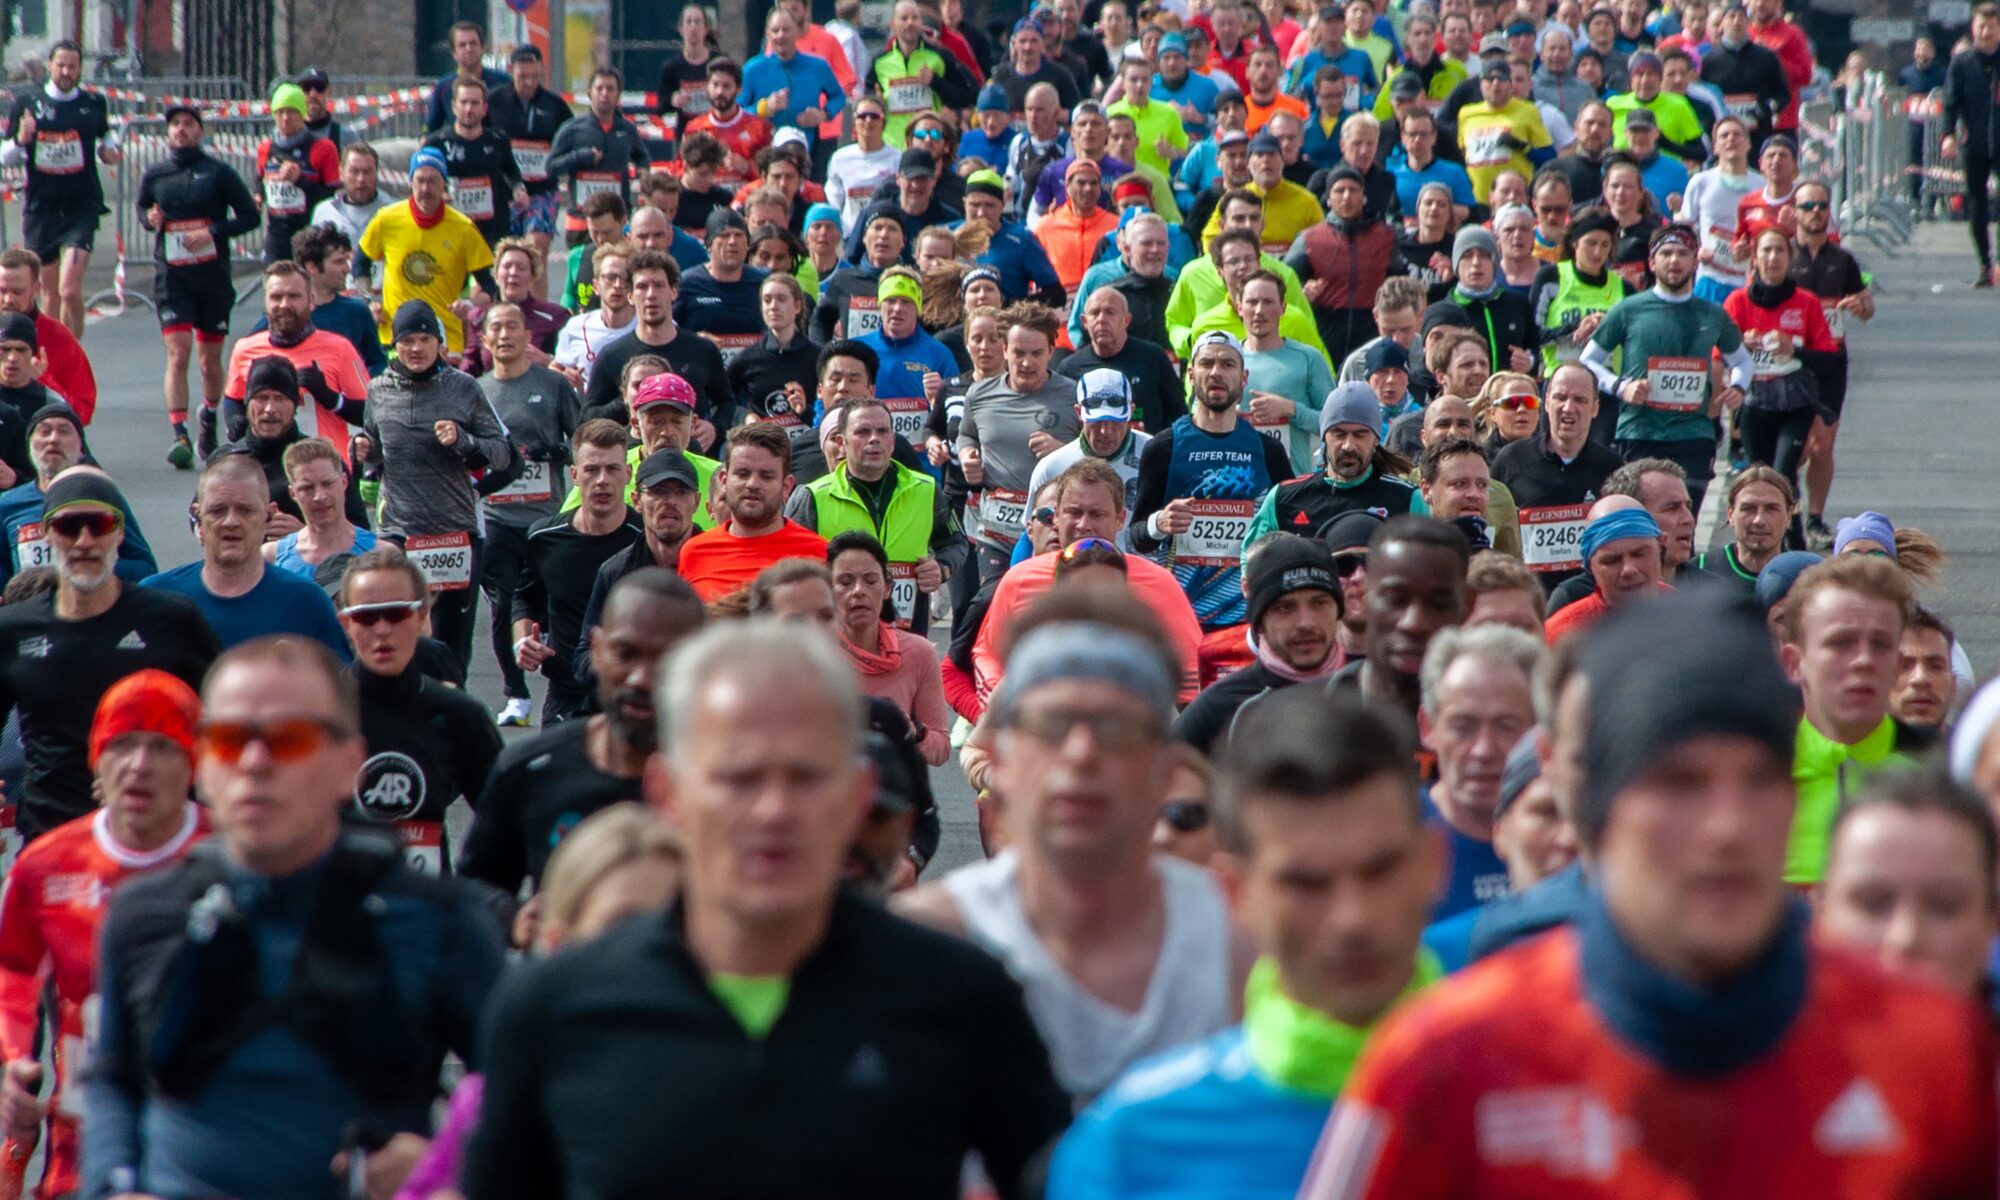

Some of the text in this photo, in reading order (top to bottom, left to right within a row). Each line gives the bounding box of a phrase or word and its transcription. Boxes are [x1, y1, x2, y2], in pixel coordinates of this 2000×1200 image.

[1660, 375, 1701, 391] 50123
[895, 415, 921, 433] 866
[1189, 451, 1252, 463] FEIFER TEAM
[996, 505, 1024, 524] 527
[1202, 503, 1245, 514] GENERALI
[1541, 508, 1584, 521] GENERALI
[1192, 520, 1246, 541] 52522
[426, 537, 463, 547] GENERALI
[1206, 542, 1229, 550] Michal
[1549, 548, 1572, 556] Stefan
[421, 552, 465, 569] 53965
[1283, 567, 1331, 581] RUN NYC
[364, 773, 411, 805] AR
